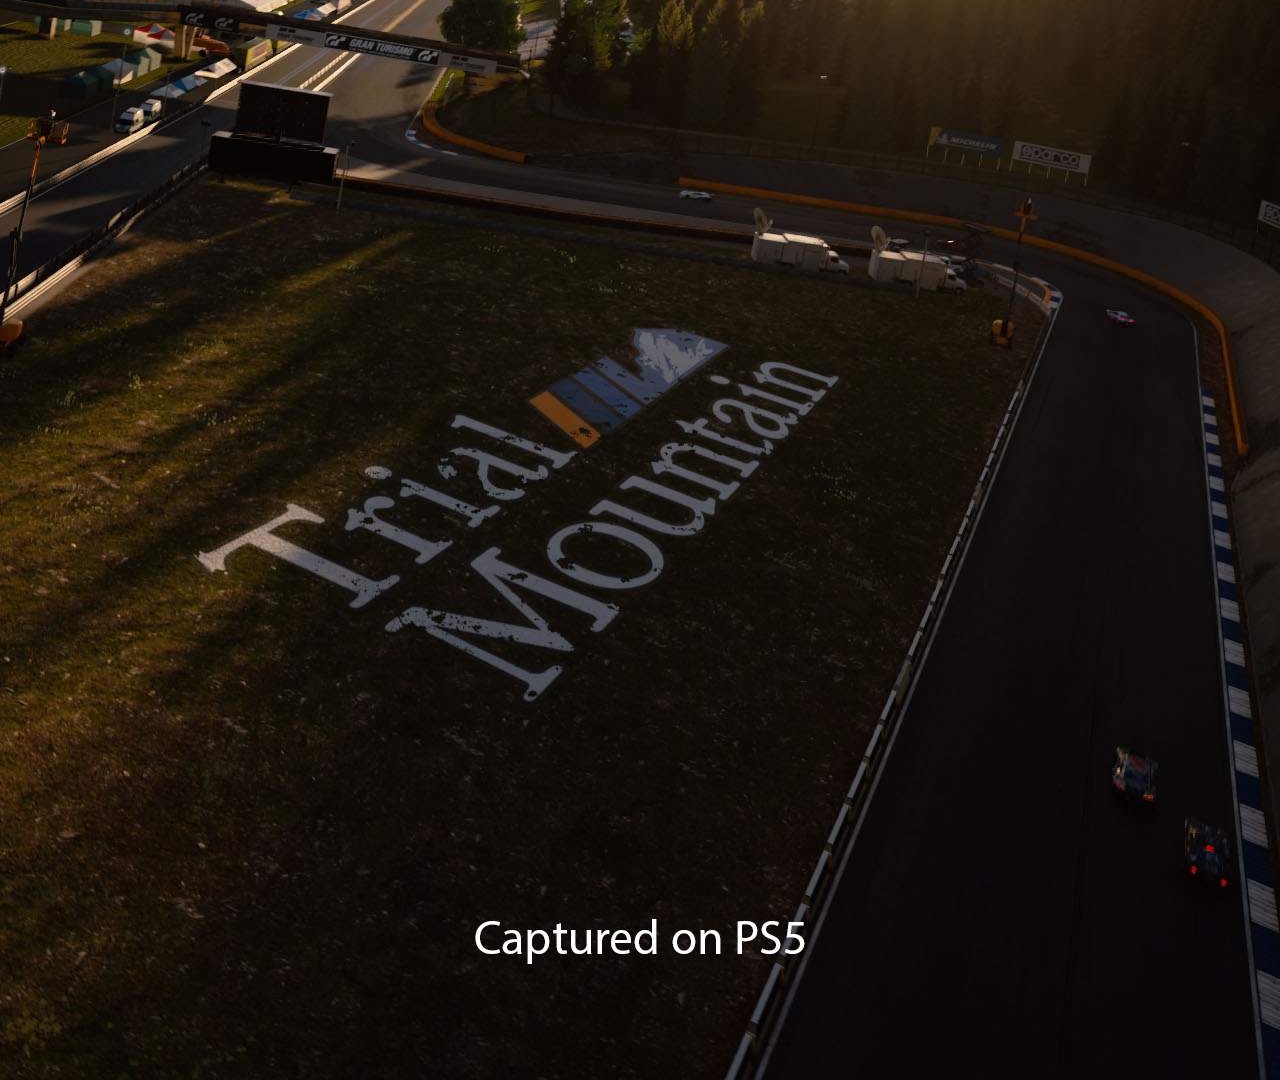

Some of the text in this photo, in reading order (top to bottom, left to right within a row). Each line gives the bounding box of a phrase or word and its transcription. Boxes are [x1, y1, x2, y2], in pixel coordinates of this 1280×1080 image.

[349, 38, 375, 51] GRAN
[375, 40, 415, 57] TURISMO
[195, 414, 578, 608] Trial
[384, 361, 839, 702] Mountain
